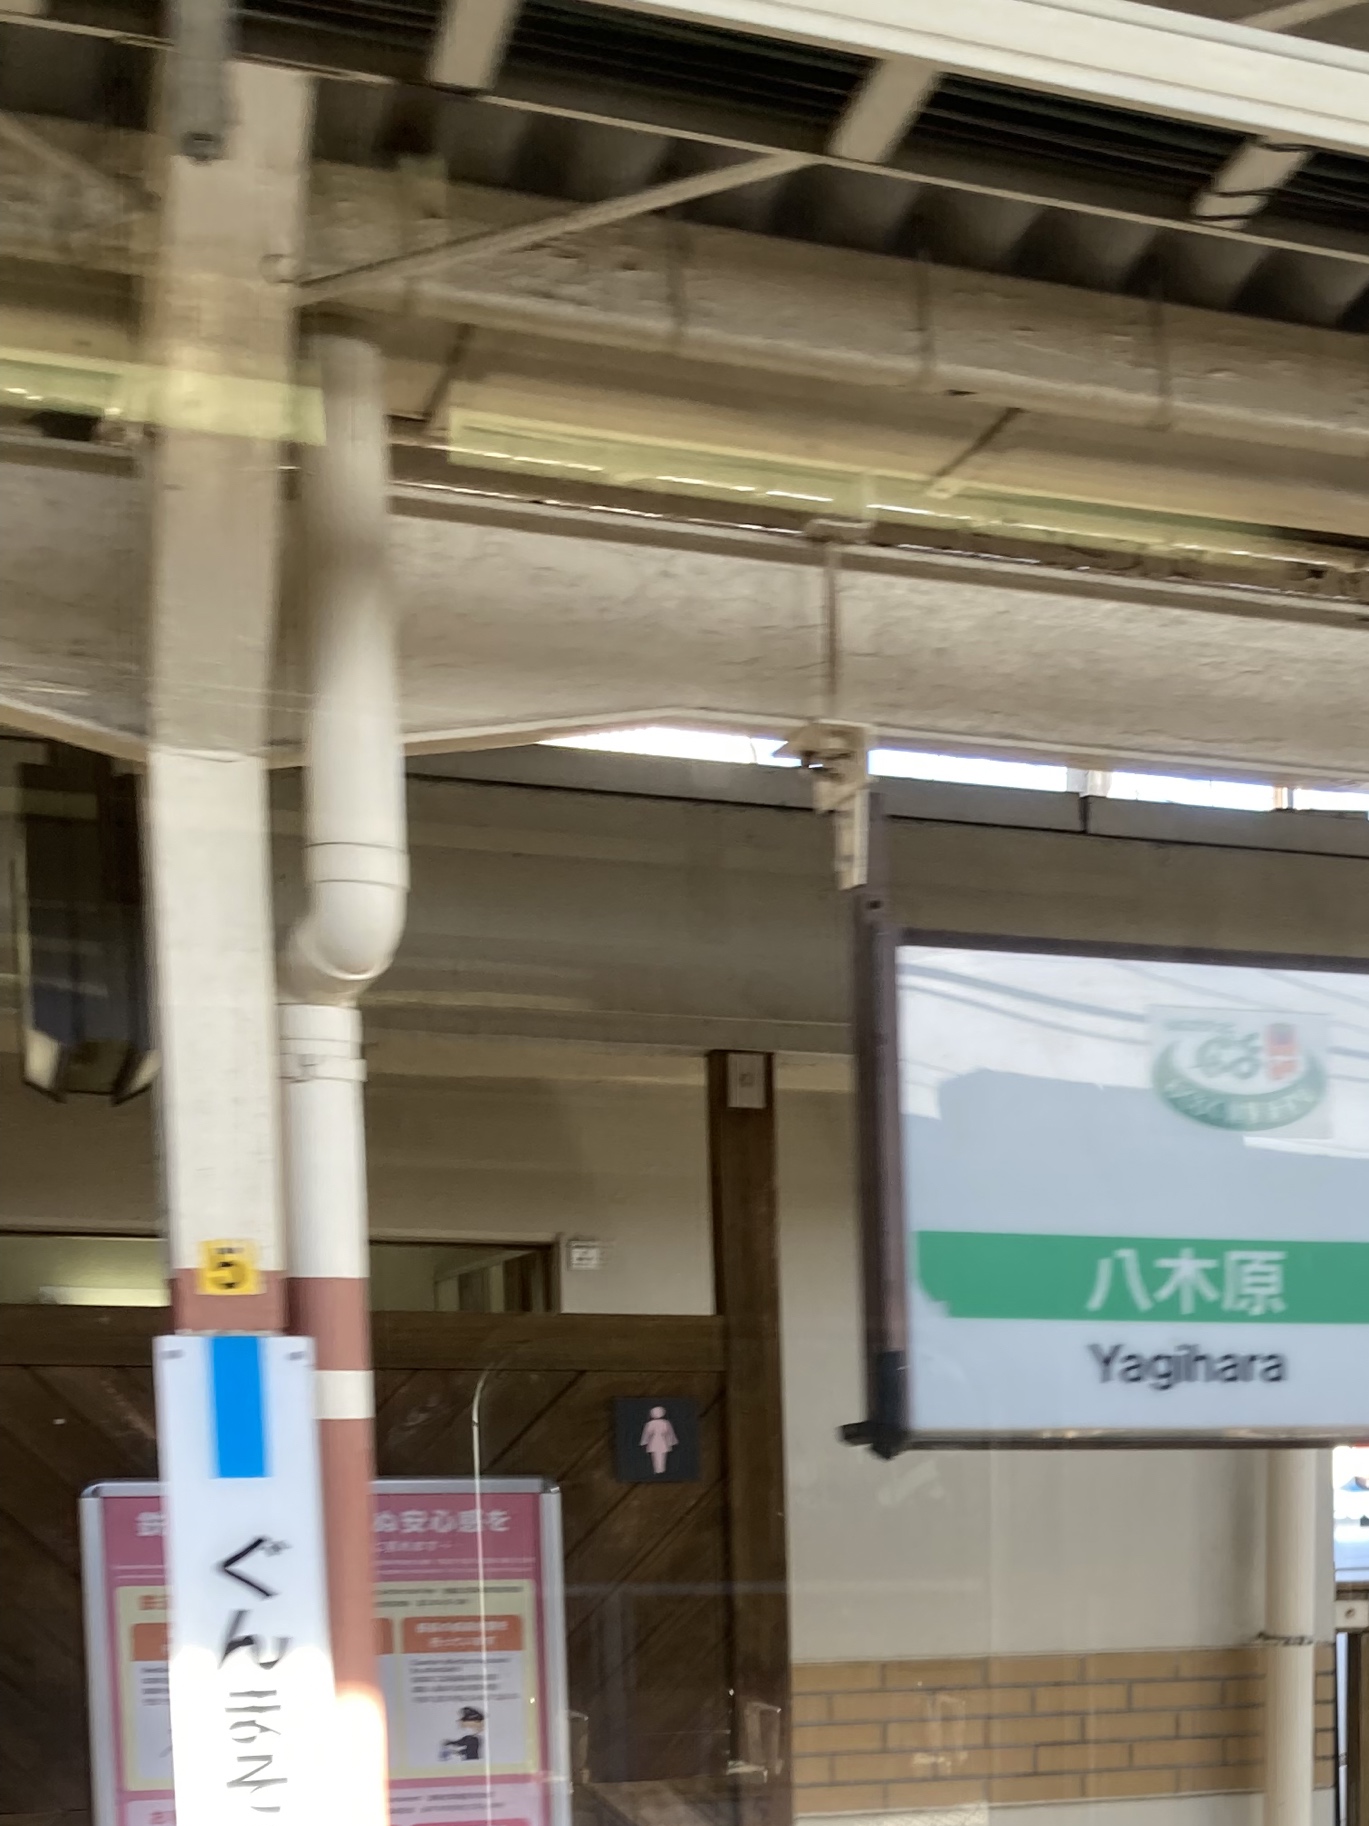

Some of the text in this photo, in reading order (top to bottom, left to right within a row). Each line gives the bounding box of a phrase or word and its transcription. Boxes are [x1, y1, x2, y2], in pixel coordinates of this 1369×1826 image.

[210, 1246, 247, 1290] 5
[1086, 1248, 1288, 1316] 八木原
[1087, 1341, 1289, 1391] Yagihara
